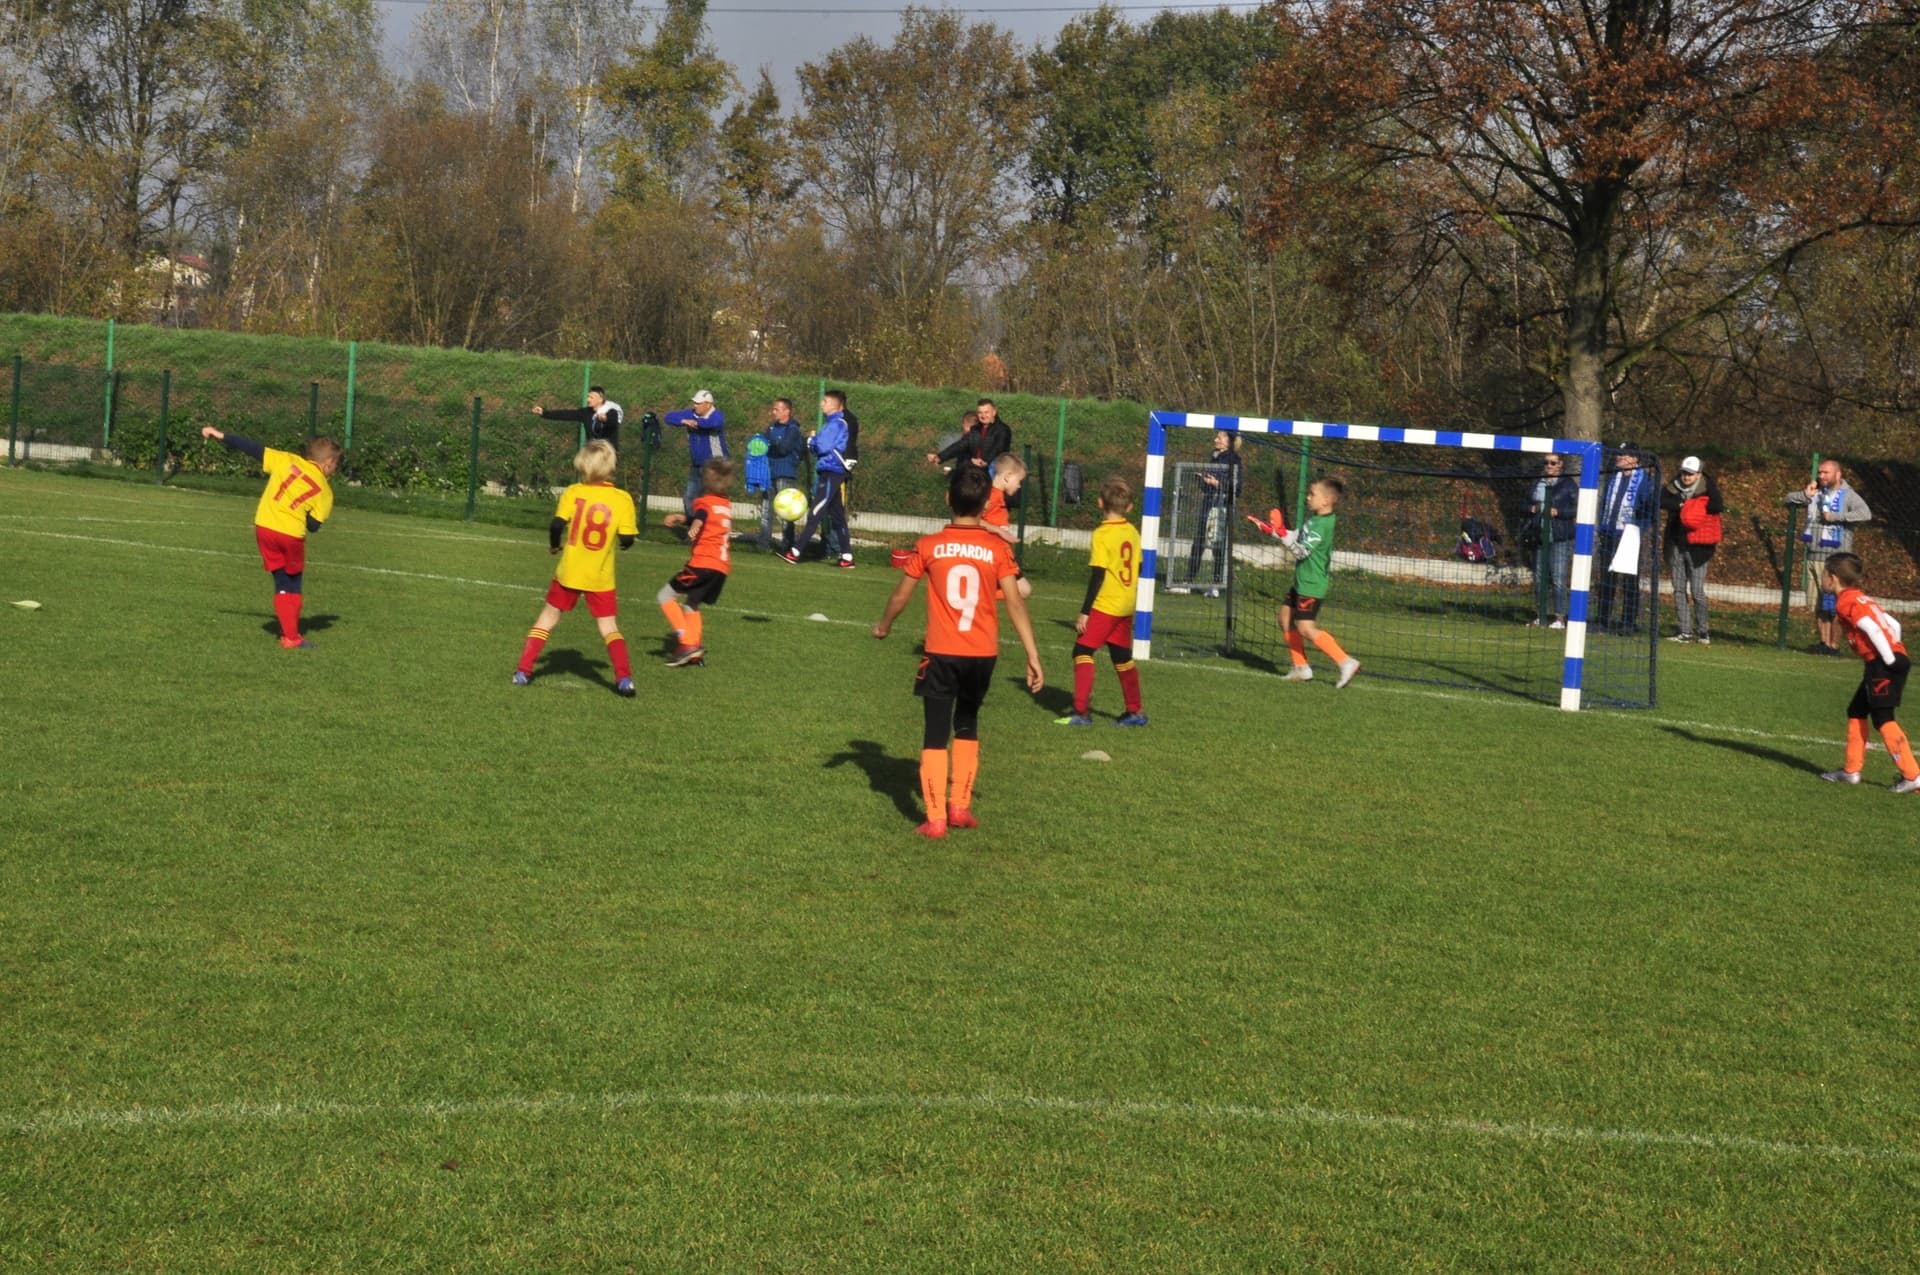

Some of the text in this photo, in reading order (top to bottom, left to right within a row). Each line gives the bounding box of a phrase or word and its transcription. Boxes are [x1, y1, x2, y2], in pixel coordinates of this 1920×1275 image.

[274, 464, 321, 510] 17
[568, 497, 612, 551] 18
[934, 543, 993, 564] CLEPARDIA
[1119, 541, 1132, 587] 3
[946, 564, 980, 631] 9
